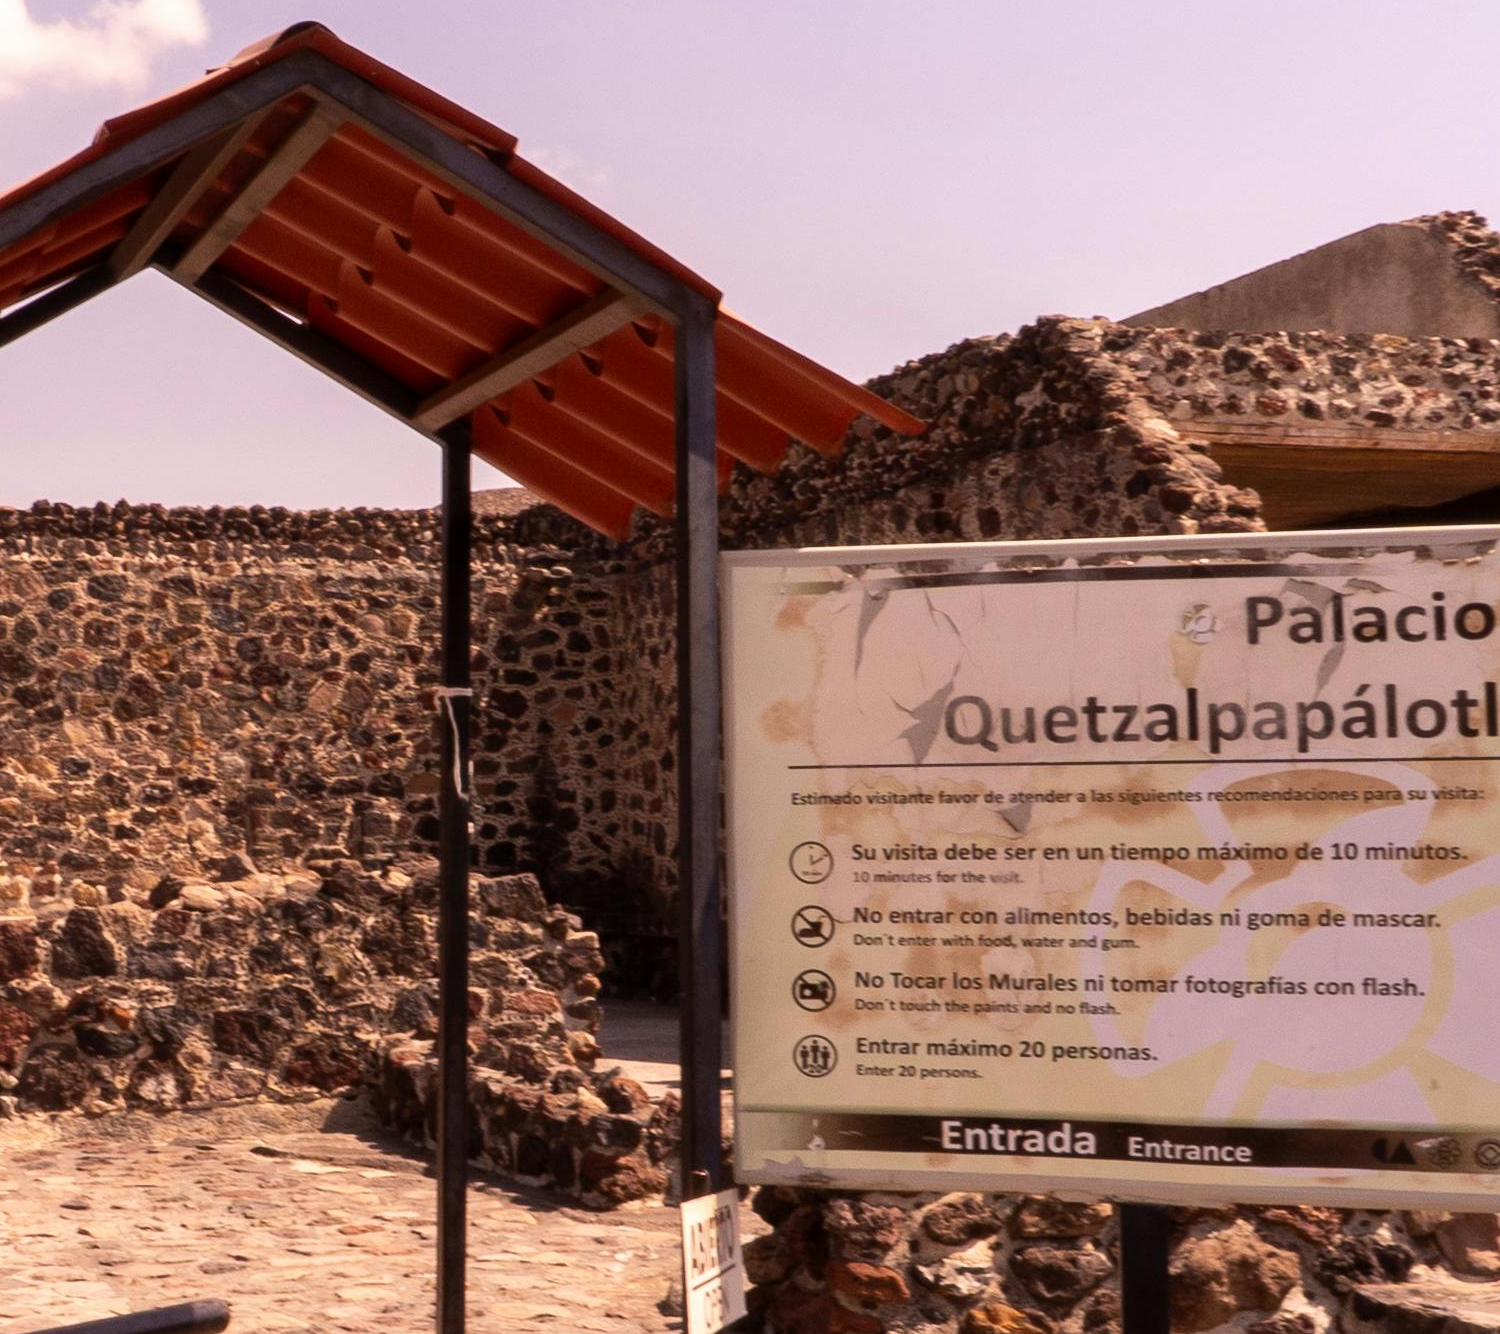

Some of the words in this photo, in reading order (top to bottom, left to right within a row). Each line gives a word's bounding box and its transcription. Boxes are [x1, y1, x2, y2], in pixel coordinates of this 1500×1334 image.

[1245, 590, 1497, 645] Palacio
[943, 682, 1500, 753] Quetzalpapálotl
[791, 792, 861, 805] Estimado
[866, 790, 933, 804] visitante
[939, 791, 979, 804] favor
[984, 790, 1004, 804] de
[1009, 790, 1072, 803] atender
[1077, 793, 1086, 803] a
[1091, 789, 1114, 803] las
[1118, 789, 1202, 805] siguientes
[1208, 788, 1360, 801] recomendaciones
[1363, 790, 1403, 804] para
[1408, 790, 1427, 801] su
[1432, 787, 1485, 800] visita:
[852, 844, 876, 861] Su
[882, 843, 938, 861] visita
[943, 843, 998, 860] debe
[1004, 848, 1035, 860] ser
[1043, 848, 1069, 860] en
[1076, 847, 1101, 860] un
[1111, 843, 1189, 864] tiempo
[1197, 841, 1288, 860] máximo
[1295, 843, 1324, 860] de
[1331, 843, 1358, 860] 10
[1366, 844, 1468, 860] minutos.
[852, 871, 869, 883] 10
[873, 871, 931, 883] minutes
[936, 871, 956, 883] for
[961, 871, 986, 883] the
[991, 871, 1024, 883] visit.
[854, 907, 882, 924] No
[889, 909, 952, 924] entrar
[960, 911, 999, 925] con
[1005, 908, 1119, 928] alimentos,
[1126, 908, 1212, 926] bebidas
[1220, 908, 1240, 926] ni
[1247, 913, 1309, 930] goma
[1317, 909, 1346, 927] de
[1353, 913, 1441, 928] mascar.
[898, 935, 936, 947] enter
[942, 935, 974, 947] with
[978, 935, 1017, 949] food,
[1022, 936, 1065, 948] water
[1069, 935, 1097, 948] and
[1101, 939, 1140, 951] gum.
[856, 971, 883, 988] No
[890, 973, 945, 989] Tocar
[953, 971, 982, 989] los
[989, 973, 1077, 991] Murales
[1084, 974, 1104, 991] ni
[1111, 978, 1178, 993] tomar
[1185, 975, 1307, 998] fotografías
[1314, 981, 1354, 996] con
[1362, 978, 1425, 996] flash.
[899, 999, 940, 1012] touch
[945, 999, 969, 1013] the
[974, 1001, 1019, 1015] paints
[1024, 1001, 1051, 1014] and
[1056, 1004, 1075, 1015] no
[1079, 1001, 1120, 1015] flash.
[857, 1038, 921, 1055] Entrar
[927, 1038, 1012, 1057] máximo
[1019, 1041, 1045, 1058] 20
[1052, 1045, 1158, 1063] personas.
[856, 1065, 894, 1076] Enter
[899, 1066, 916, 1077] 20
[921, 1066, 982, 1079] persons.
[941, 1119, 1097, 1158] Entrada
[1128, 1137, 1253, 1164] Entrance
